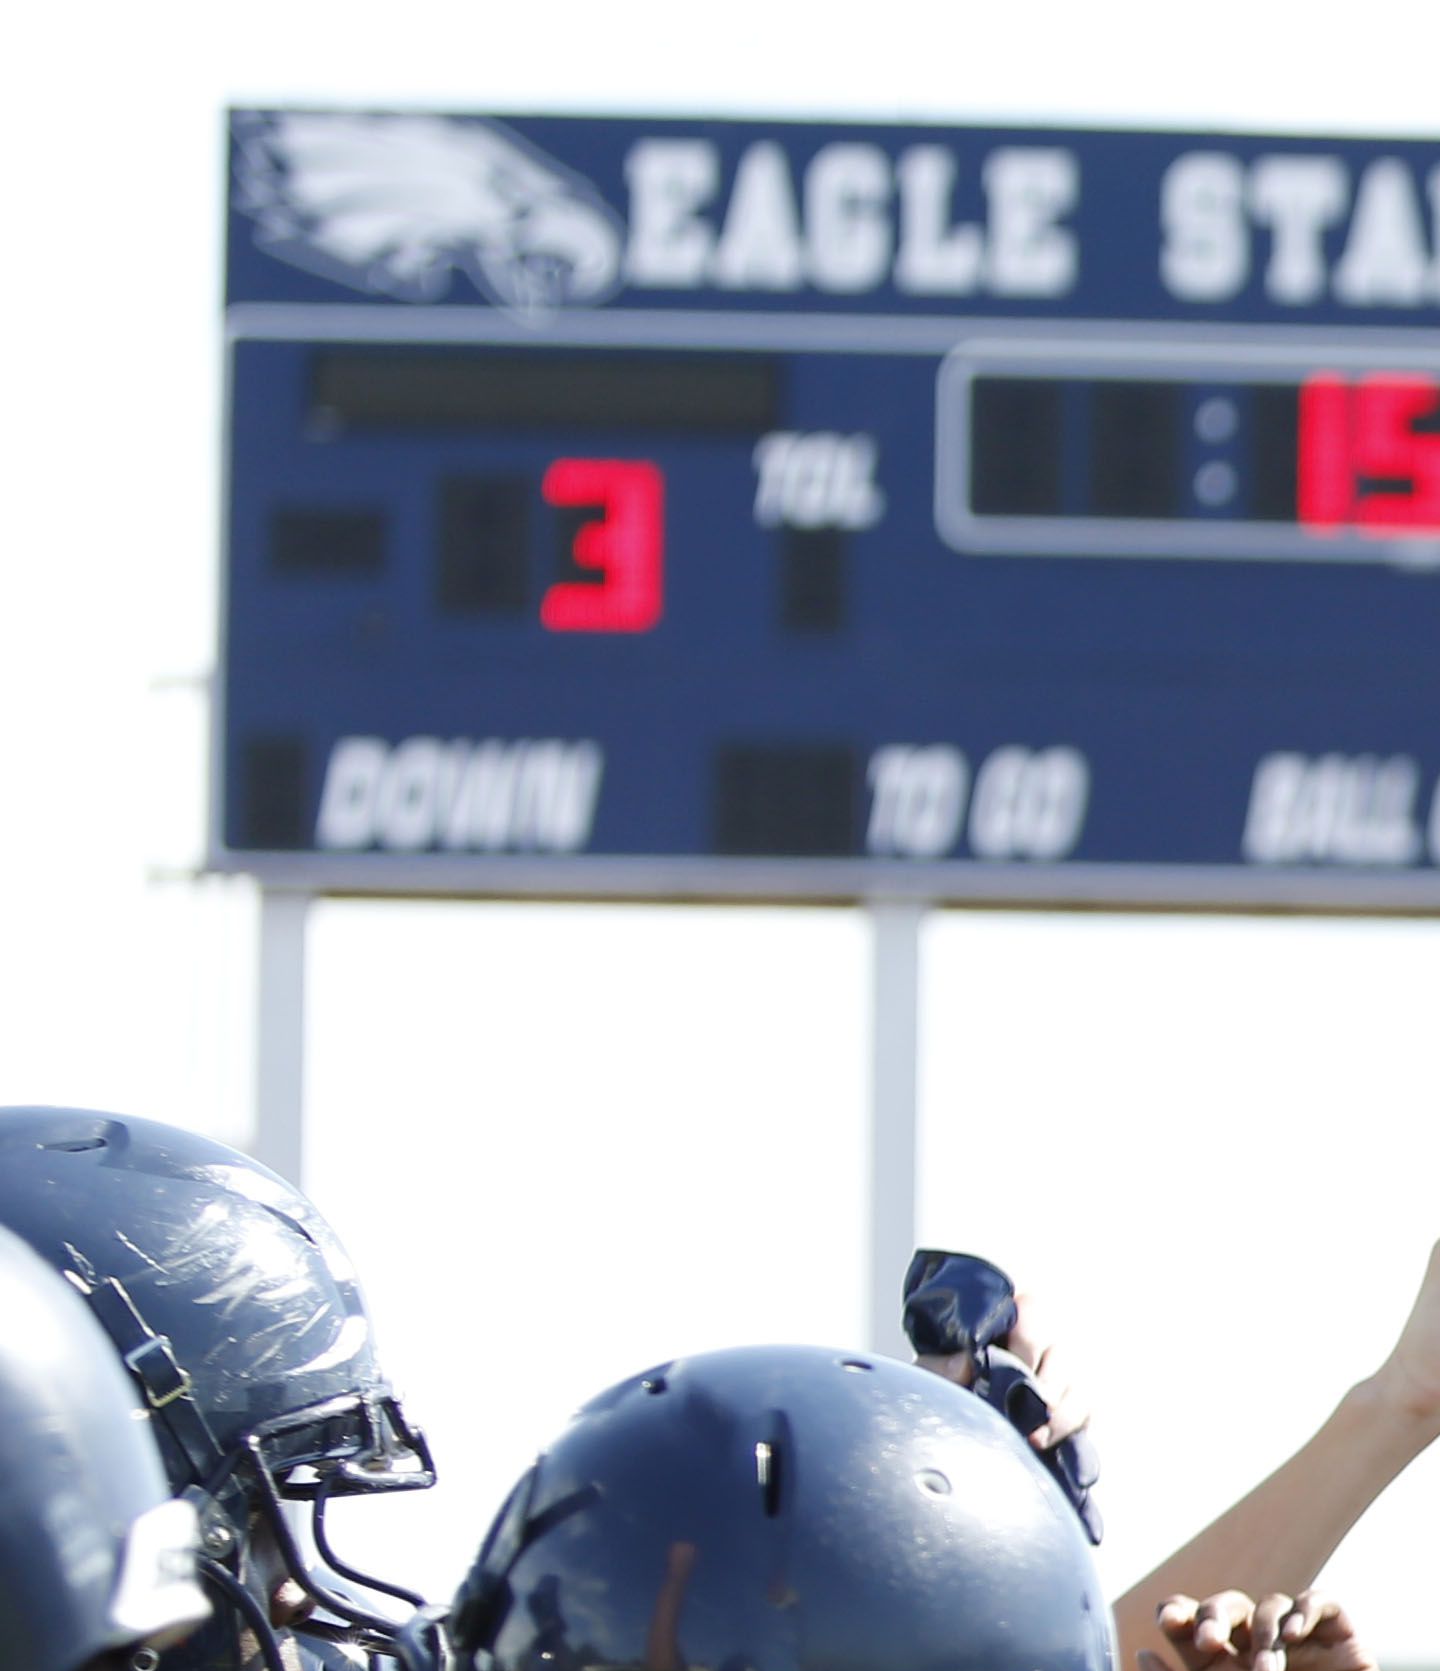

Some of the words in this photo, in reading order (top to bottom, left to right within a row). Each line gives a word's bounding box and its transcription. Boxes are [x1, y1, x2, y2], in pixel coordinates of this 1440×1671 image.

[622, 138, 1082, 300] EAGLE
[540, 457, 666, 633] 3
[315, 736, 603, 853] DOWN
[866, 742, 968, 858] TO
[968, 744, 1090, 863] GO
[1242, 752, 1422, 866] BALL
